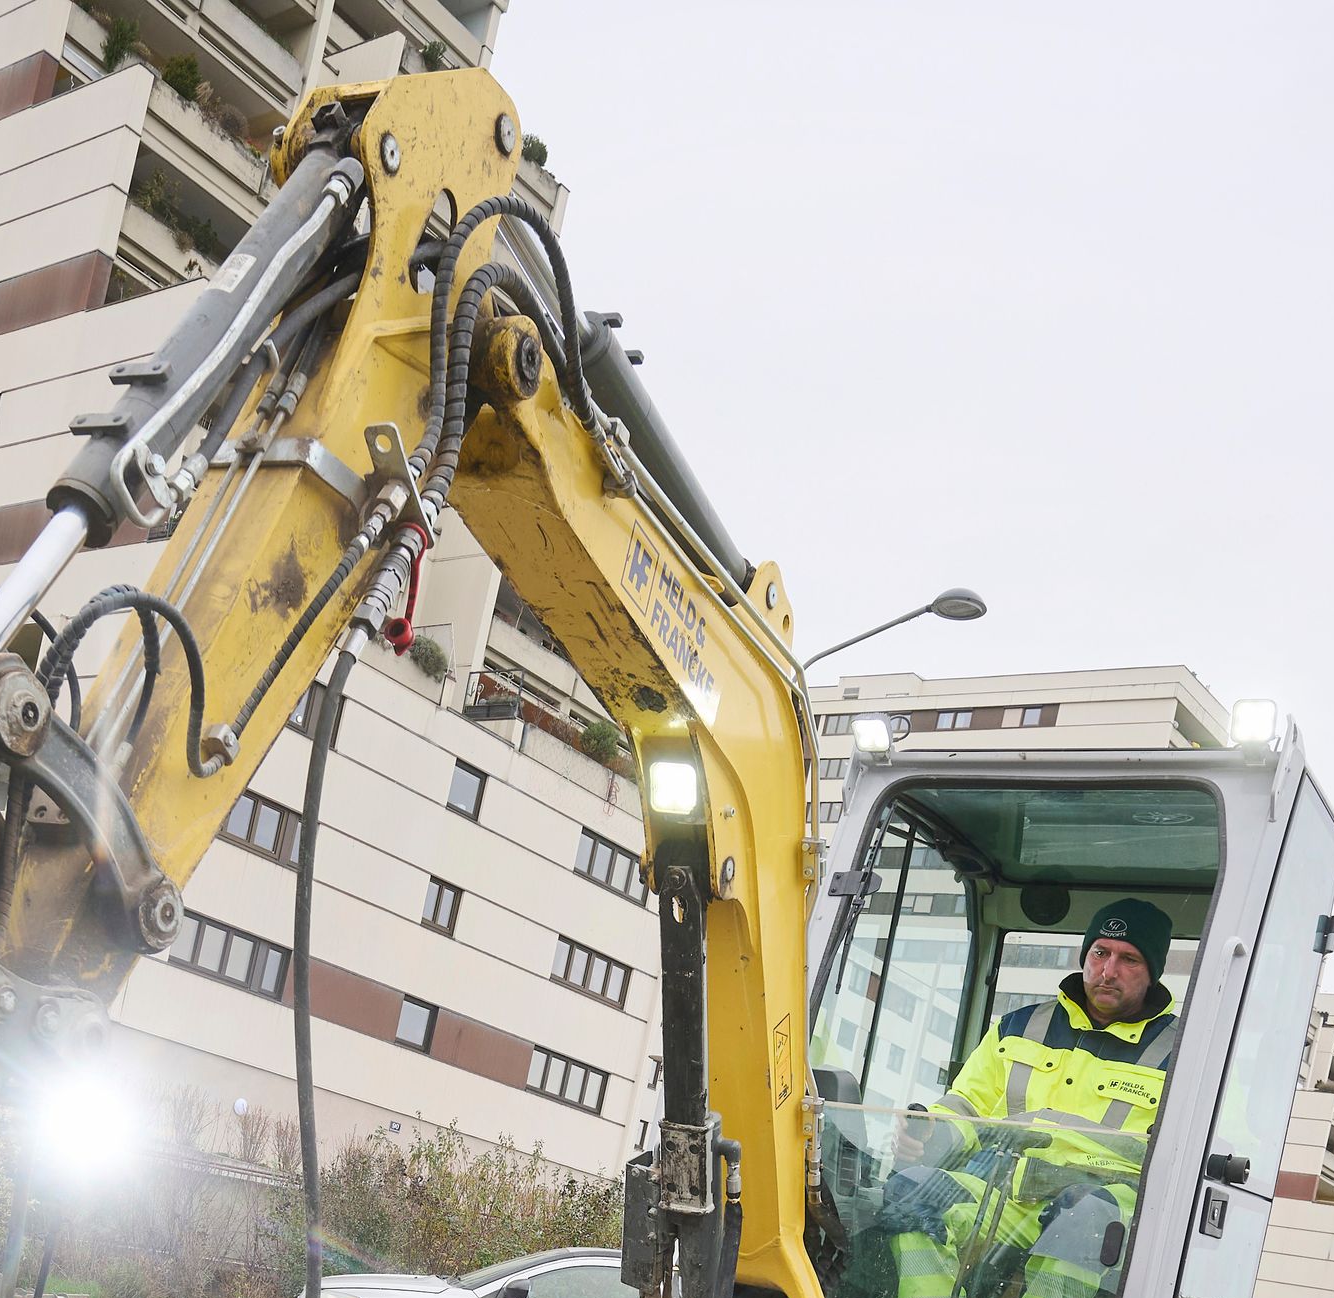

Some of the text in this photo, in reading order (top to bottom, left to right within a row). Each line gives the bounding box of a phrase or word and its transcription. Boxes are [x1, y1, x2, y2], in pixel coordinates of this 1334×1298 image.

[658, 561, 706, 649] HELD &
[650, 597, 715, 696] FRANCKE
[1119, 1086, 1151, 1099] FRANCKE
[1121, 1081, 1140, 1089] HELD
